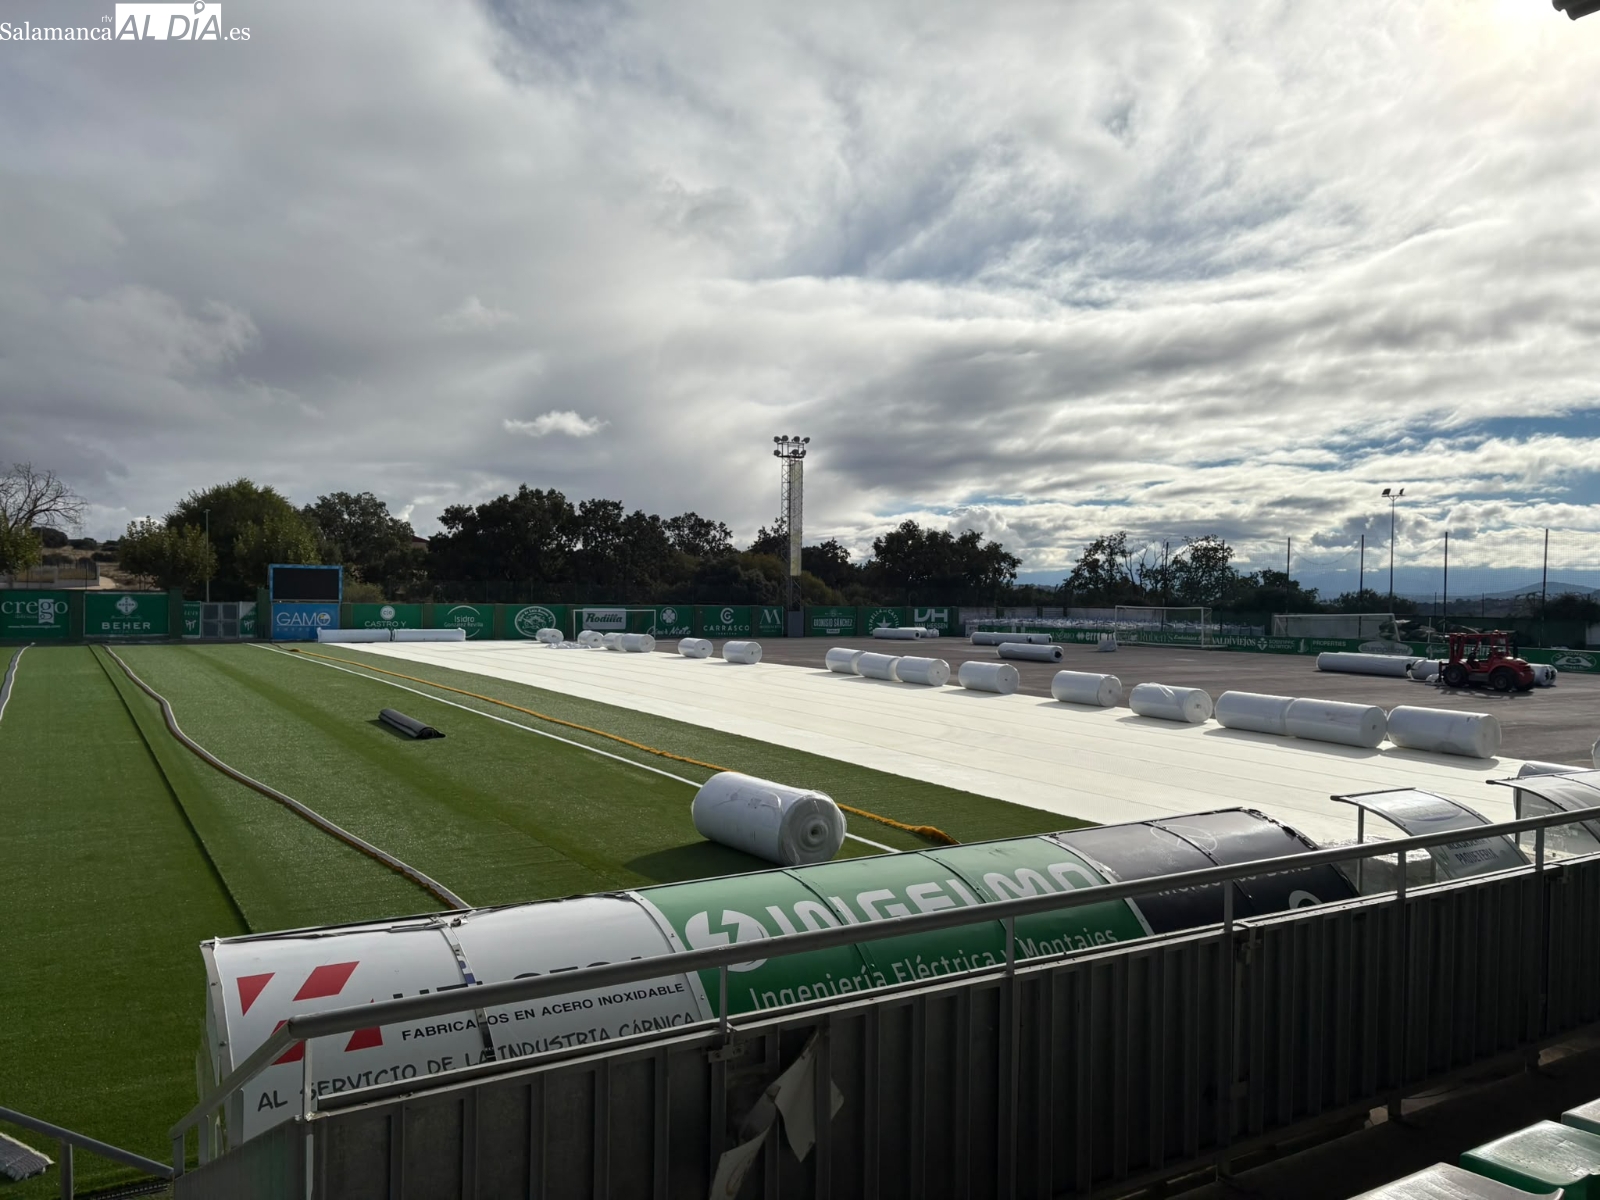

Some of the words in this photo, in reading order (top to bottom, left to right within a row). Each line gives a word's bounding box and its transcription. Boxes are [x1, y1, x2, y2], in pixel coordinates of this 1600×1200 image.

[1, 600, 69, 620] crego
[585, 612, 623, 623] Rodilla
[101, 622, 151, 630] BEHER
[276, 611, 331, 626] GAMO
[364, 620, 399, 628] CASTRO
[400, 620, 407, 628] Y
[454, 615, 475, 623] Isidro
[891, 950, 997, 982] Eléctrica
[401, 1012, 509, 1041] FABRICAOS
[514, 1008, 537, 1022] EN
[541, 998, 594, 1017] ACERO
[598, 982, 685, 1007] INOXIDABLE
[257, 1089, 288, 1113] AL
[427, 1056, 454, 1075] DE
[496, 1027, 612, 1061] INDUSTRIA
[618, 1011, 696, 1038] CÁRNICA
